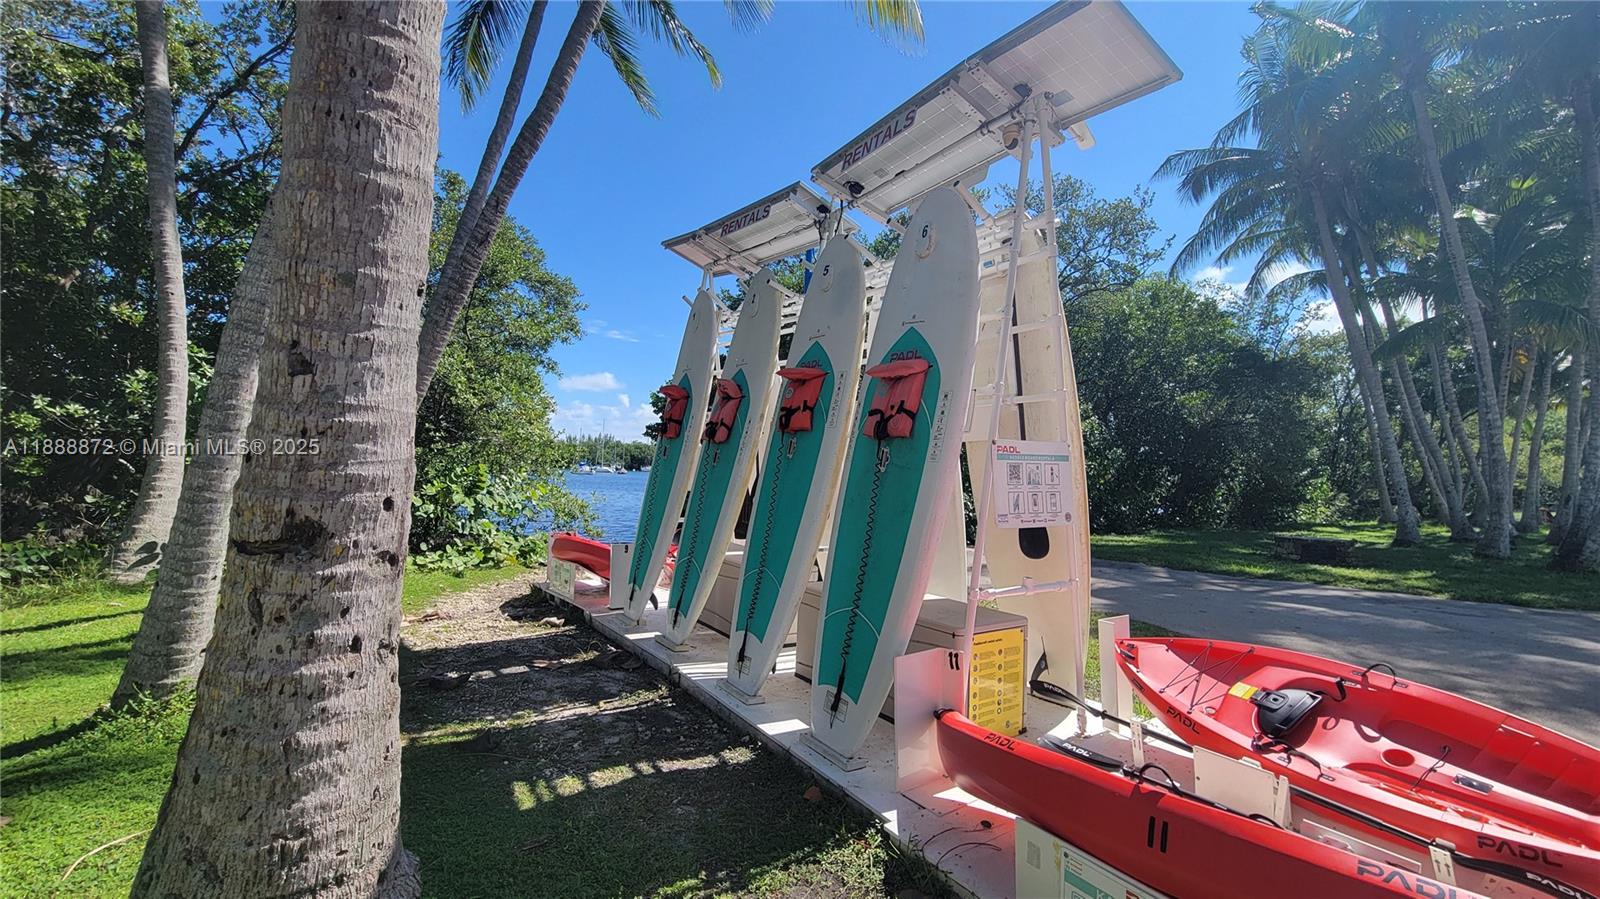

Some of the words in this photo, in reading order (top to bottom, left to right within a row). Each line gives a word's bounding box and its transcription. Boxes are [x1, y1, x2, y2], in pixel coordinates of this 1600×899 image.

[840, 108, 917, 172] RENTALS
[720, 204, 771, 237] RENTALS
[921, 225, 929, 239] 6
[822, 264, 830, 277] 5
[889, 350, 922, 363] PADL
[996, 445, 1021, 454] PADL
[948, 651, 961, 670] 11
[1166, 706, 1200, 735] PADL
[983, 732, 1016, 751] PADL
[1062, 742, 1090, 757] PADL
[1147, 815, 1168, 854] 11
[1476, 835, 1563, 868] PADL
